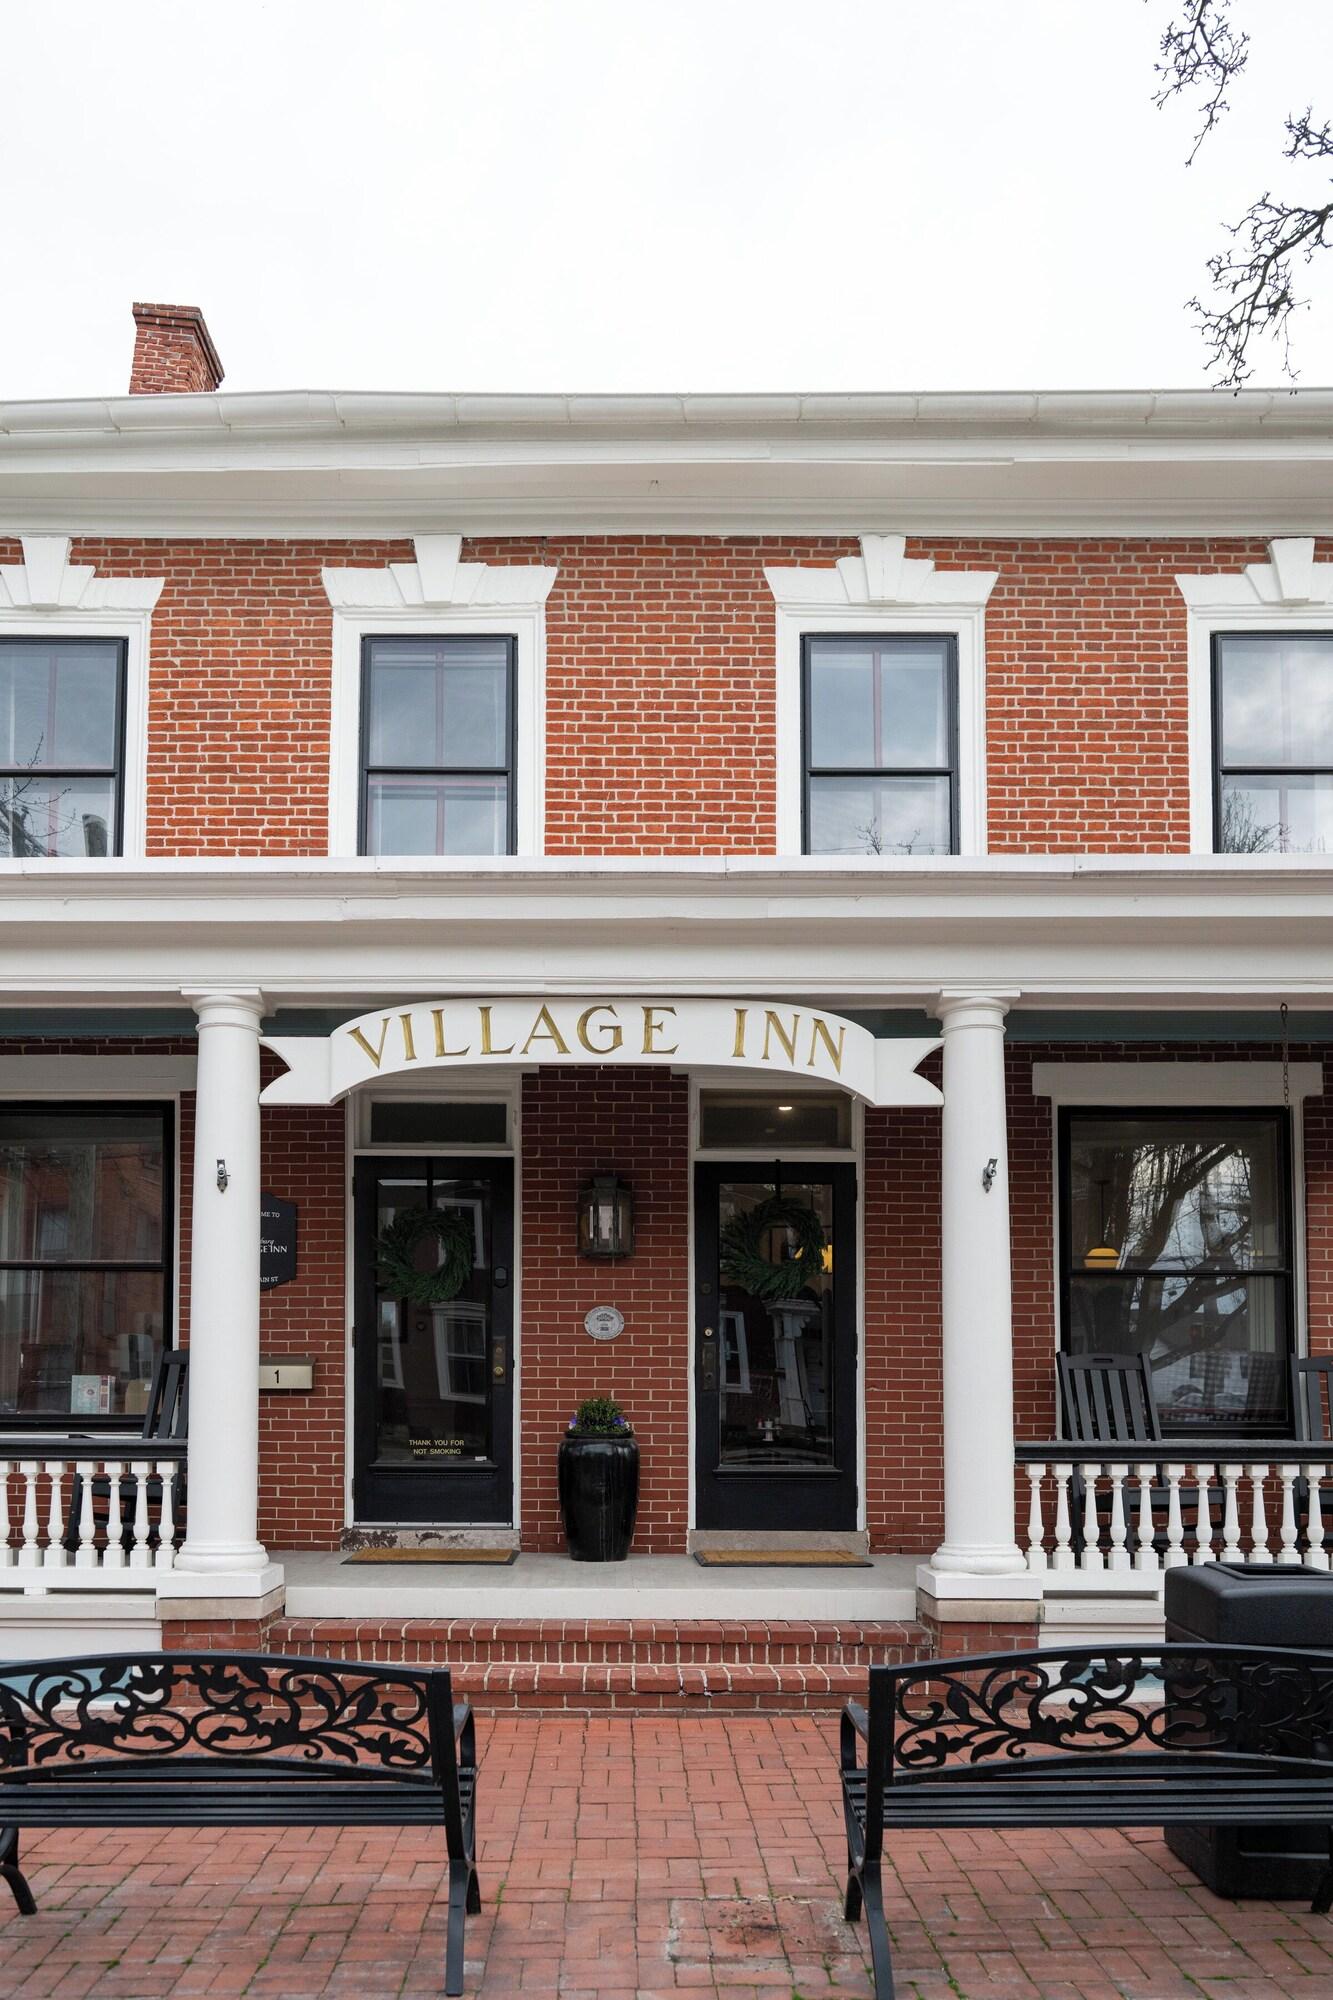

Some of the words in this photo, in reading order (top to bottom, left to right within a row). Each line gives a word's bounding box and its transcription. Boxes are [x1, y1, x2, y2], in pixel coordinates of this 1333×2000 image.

[346, 1002, 679, 1069] VILLAGE
[732, 1008, 847, 1075] INN
[270, 1245, 287, 1253] INN
[274, 1369, 280, 1384] 1
